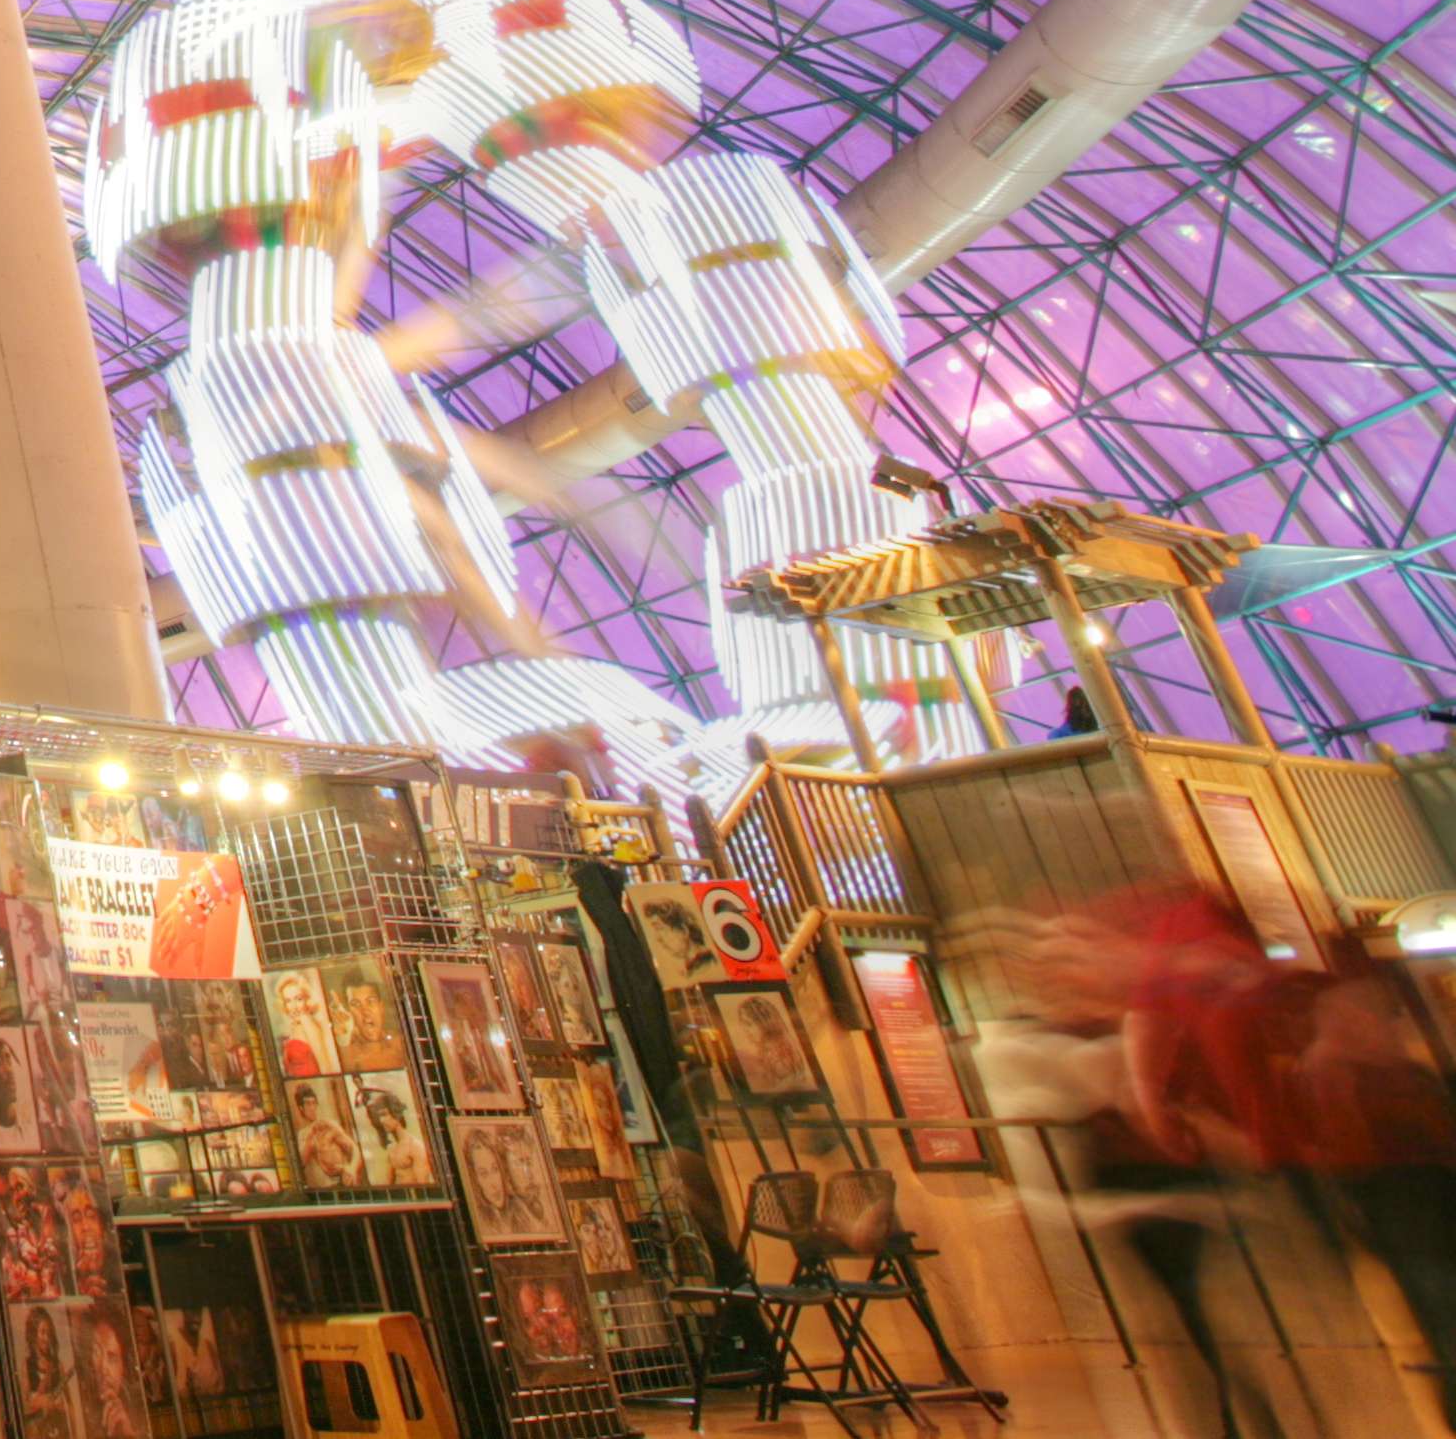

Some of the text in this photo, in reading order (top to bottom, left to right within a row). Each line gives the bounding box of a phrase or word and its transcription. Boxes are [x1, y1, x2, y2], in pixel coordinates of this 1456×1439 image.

[91, 850, 133, 874] YOUR
[139, 856, 178, 877] OWN
[59, 875, 159, 919] AME BRACELET
[702, 887, 763, 963] 6
